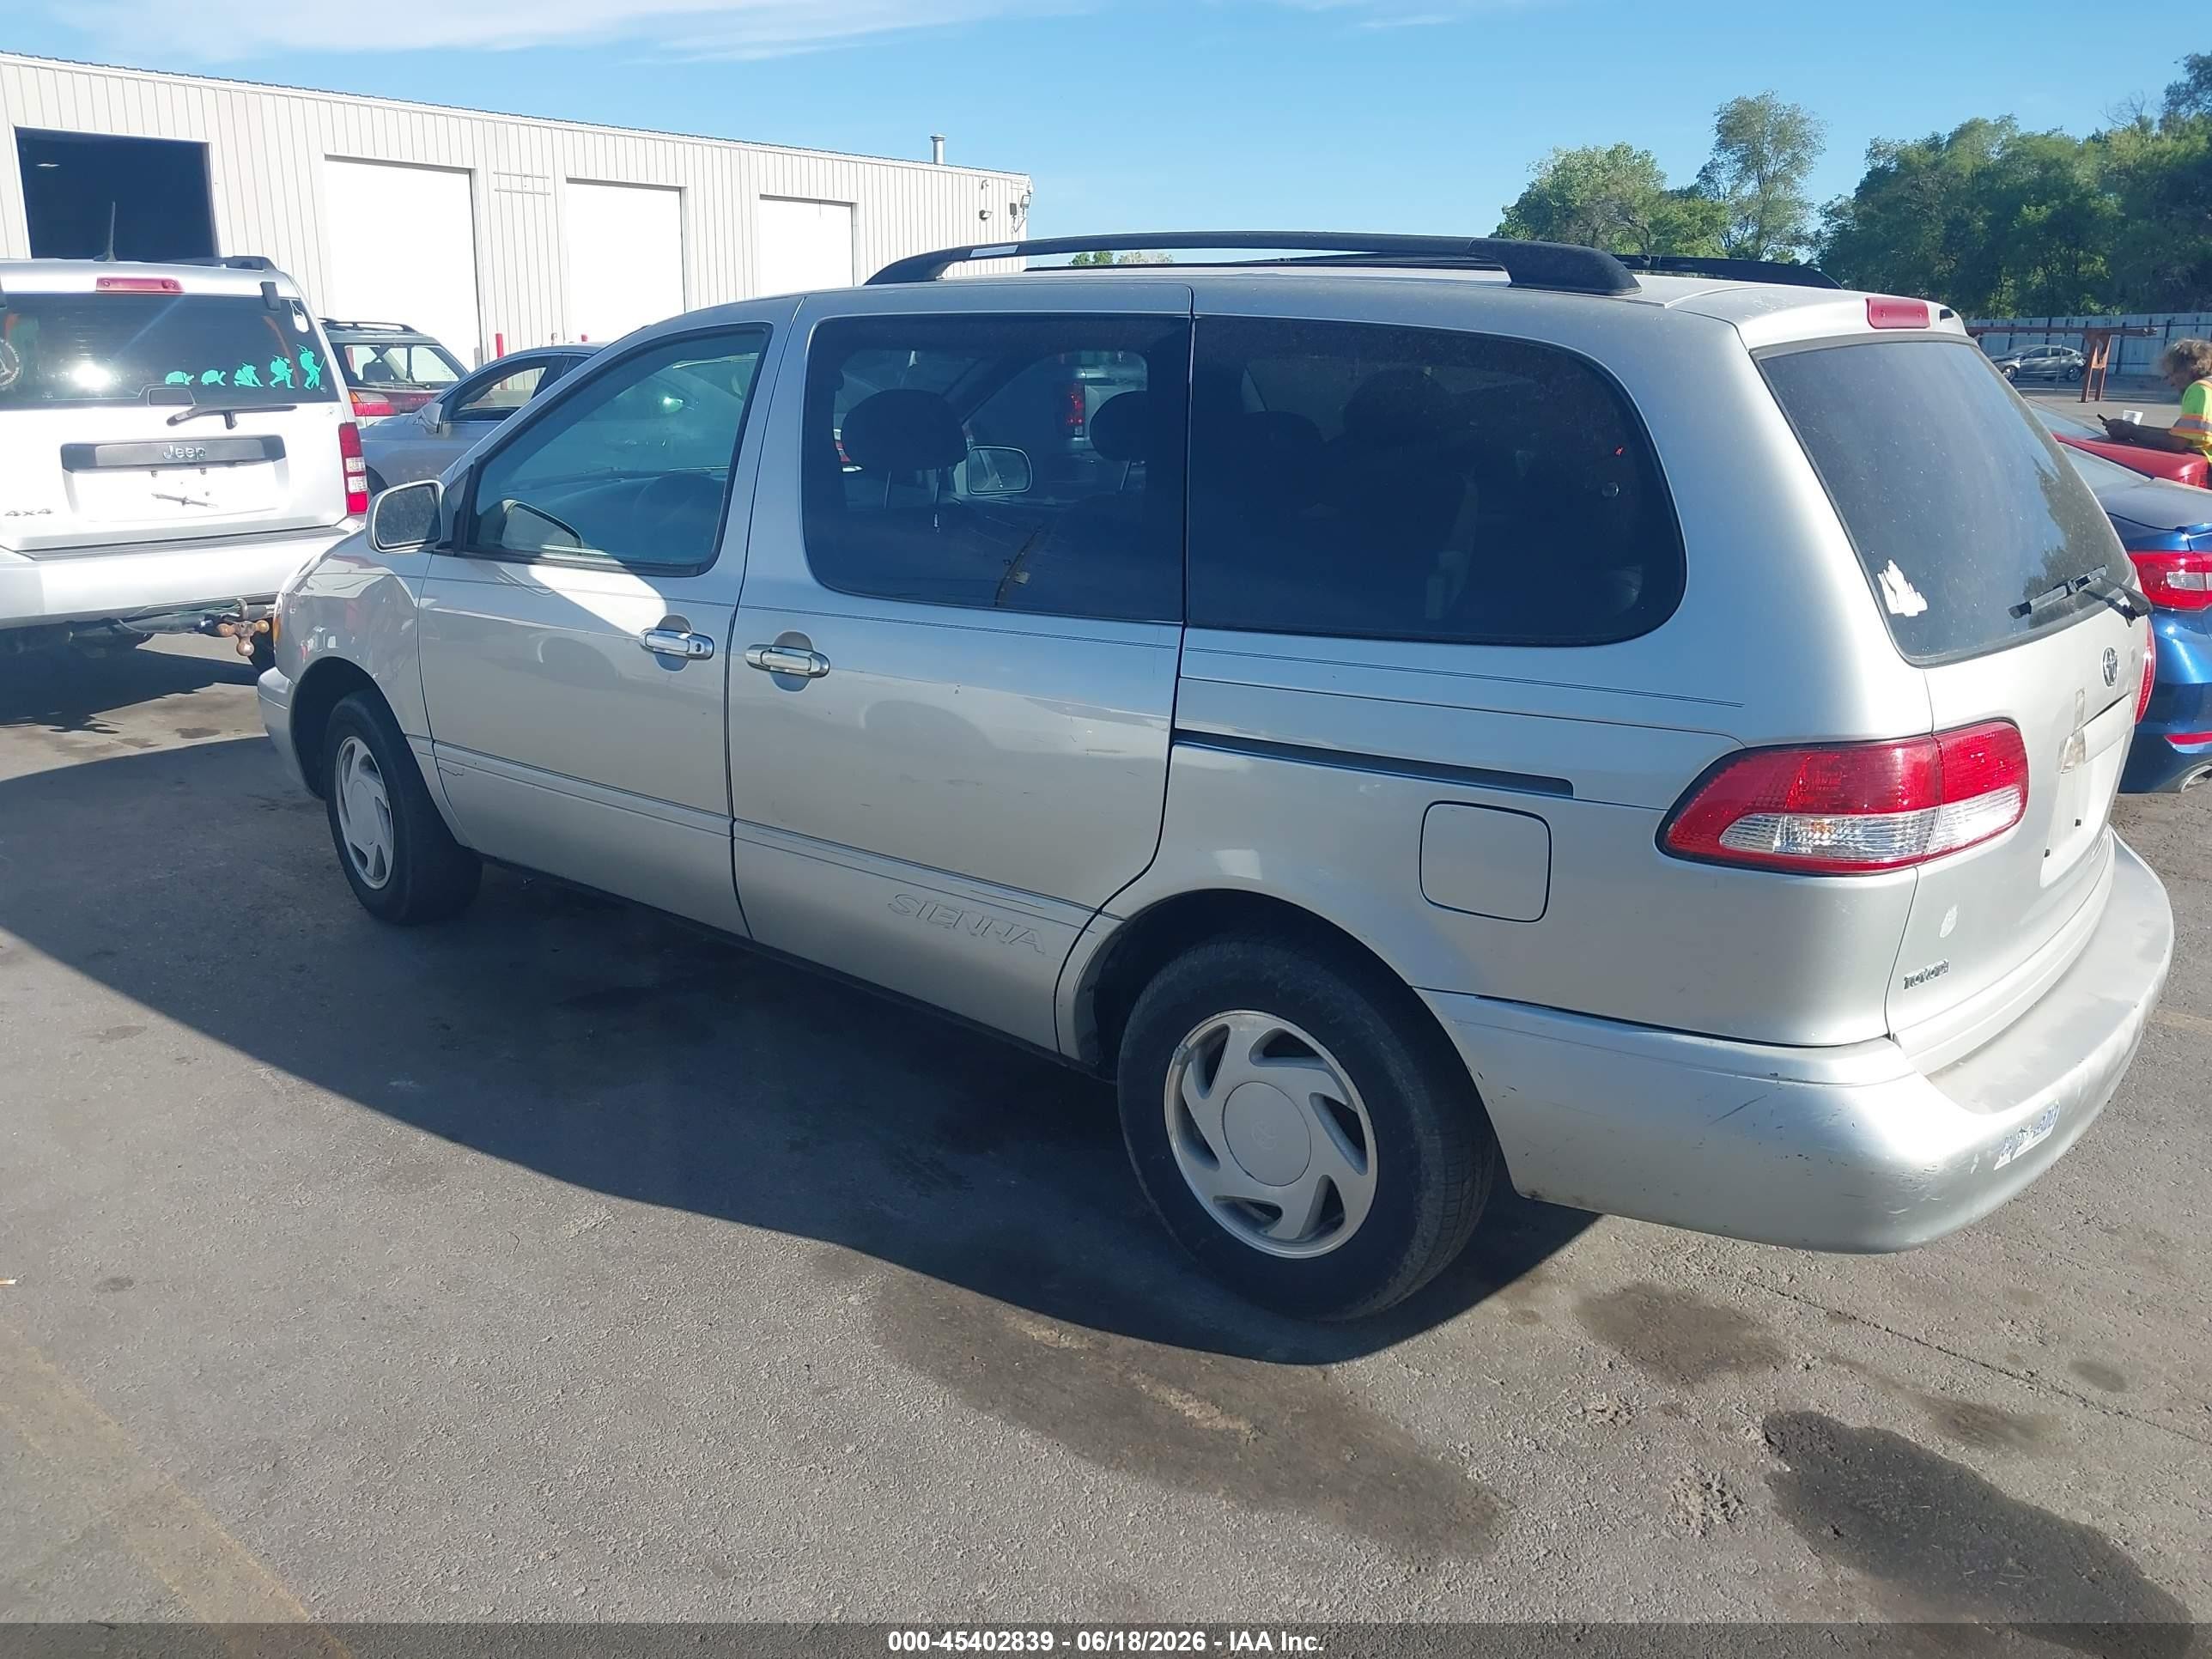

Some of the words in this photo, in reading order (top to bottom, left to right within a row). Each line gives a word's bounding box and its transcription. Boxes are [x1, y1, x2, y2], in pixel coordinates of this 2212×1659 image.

[163, 445, 207, 461] Jeep
[887, 893, 1045, 955] SIENNA
[1903, 958, 1949, 989] TOYOTA
